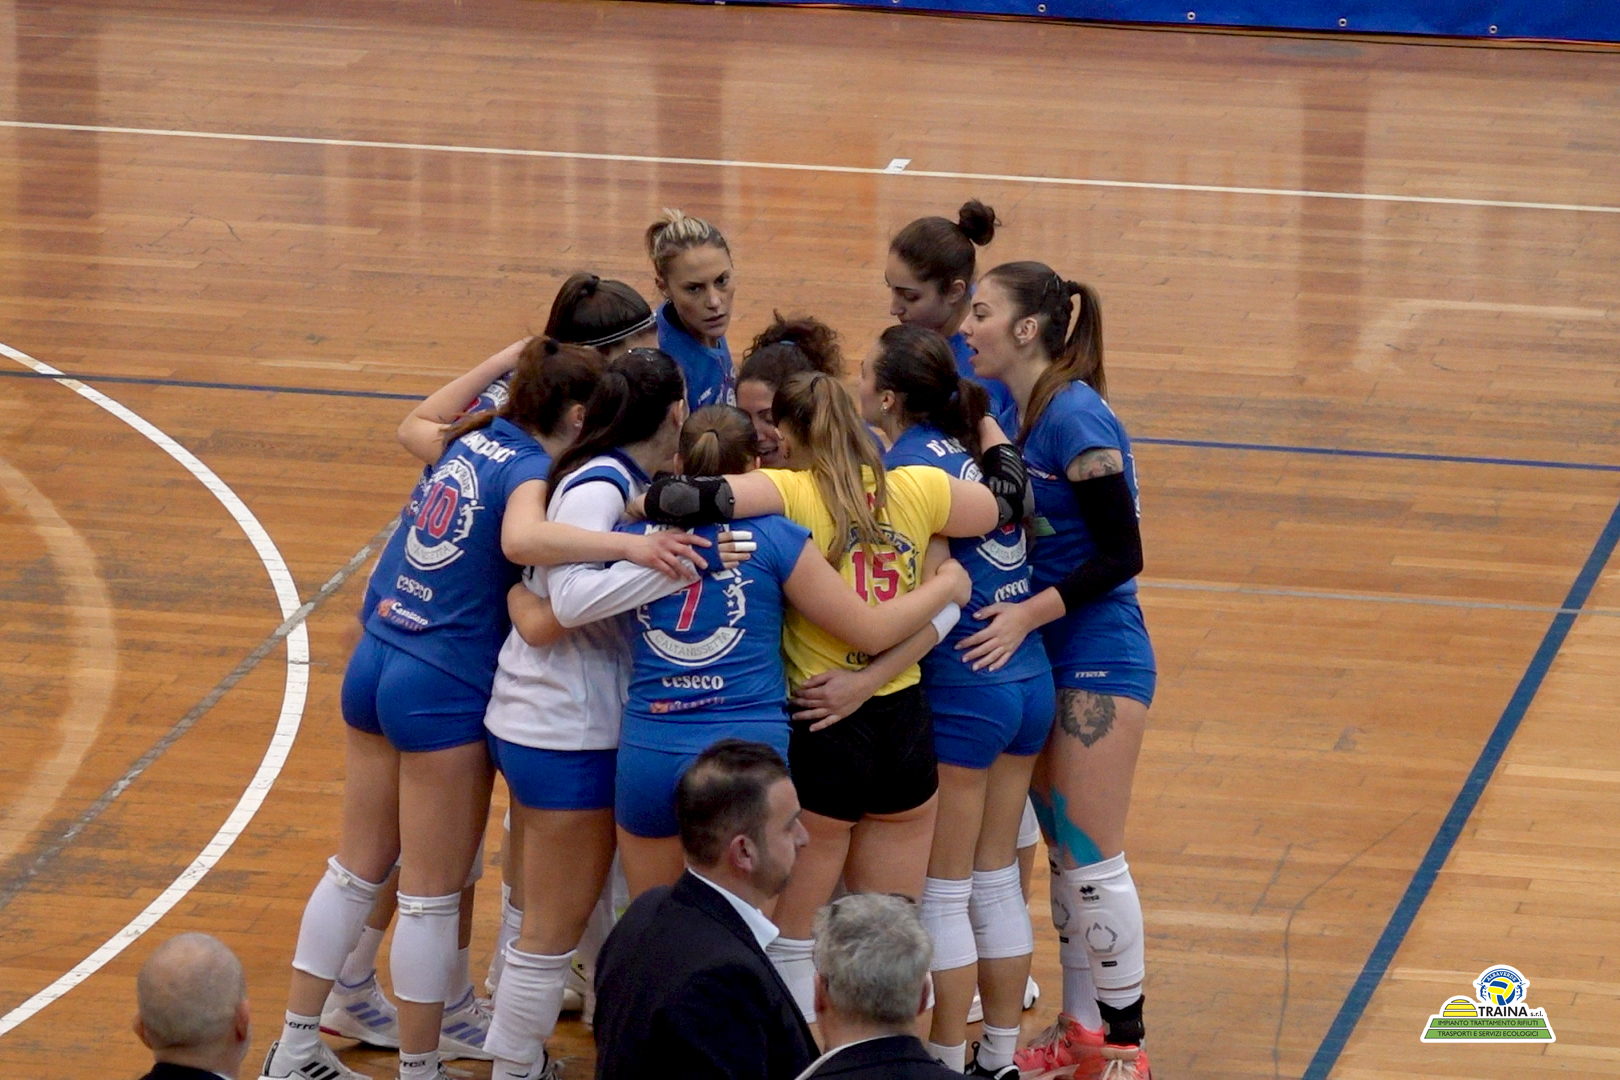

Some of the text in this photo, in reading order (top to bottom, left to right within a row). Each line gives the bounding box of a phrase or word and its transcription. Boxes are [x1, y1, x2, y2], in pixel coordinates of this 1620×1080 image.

[416, 481, 459, 539] 10
[851, 550, 900, 603] 15
[672, 578, 703, 632] 7
[655, 630, 730, 657] CALTANISSETTA
[661, 675, 724, 690] ceseco
